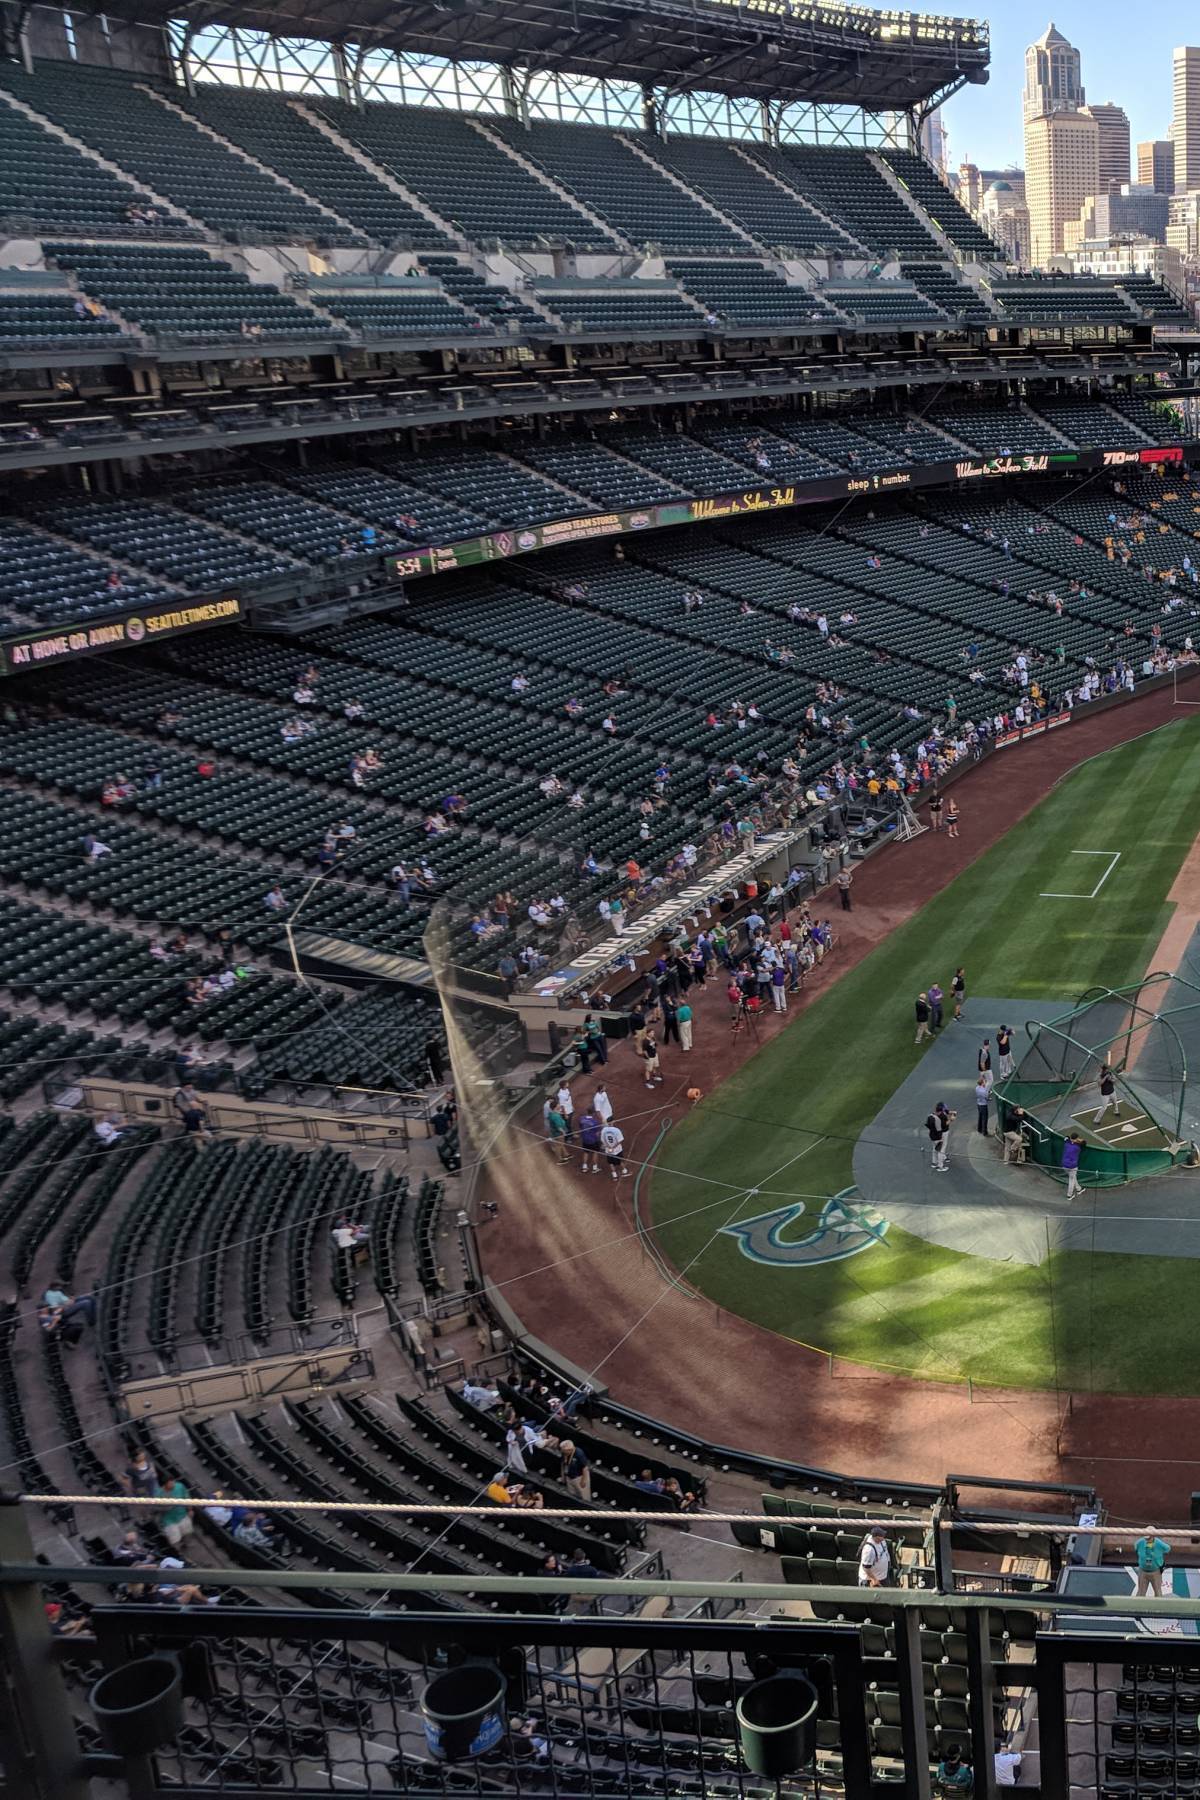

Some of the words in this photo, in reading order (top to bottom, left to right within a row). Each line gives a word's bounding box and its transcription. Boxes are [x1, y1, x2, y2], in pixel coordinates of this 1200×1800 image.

[955, 461, 983, 478] Welcome
[982, 460, 991, 474] to
[991, 456, 1022, 475] Safeco
[1022, 455, 1048, 472] Field
[1103, 452, 1126, 465] 710
[1140, 447, 1183, 463] ESPN
[847, 478, 869, 491] sleep
[882, 473, 910, 486] number
[691, 501, 731, 520] Welcome
[731, 500, 740, 513] to
[742, 494, 771, 512] Safeco
[771, 488, 795, 508] Field
[145, 599, 241, 634] SEATTLETIMES.COM
[12, 644, 31, 664] AT
[31, 636, 70, 660] HOME
[68, 632, 90, 651] OR
[89, 623, 125, 647] AWAY
[677, 884, 715, 898] TO
[623, 898, 692, 935] SAFECO
[568, 936, 633, 968] FIELD
